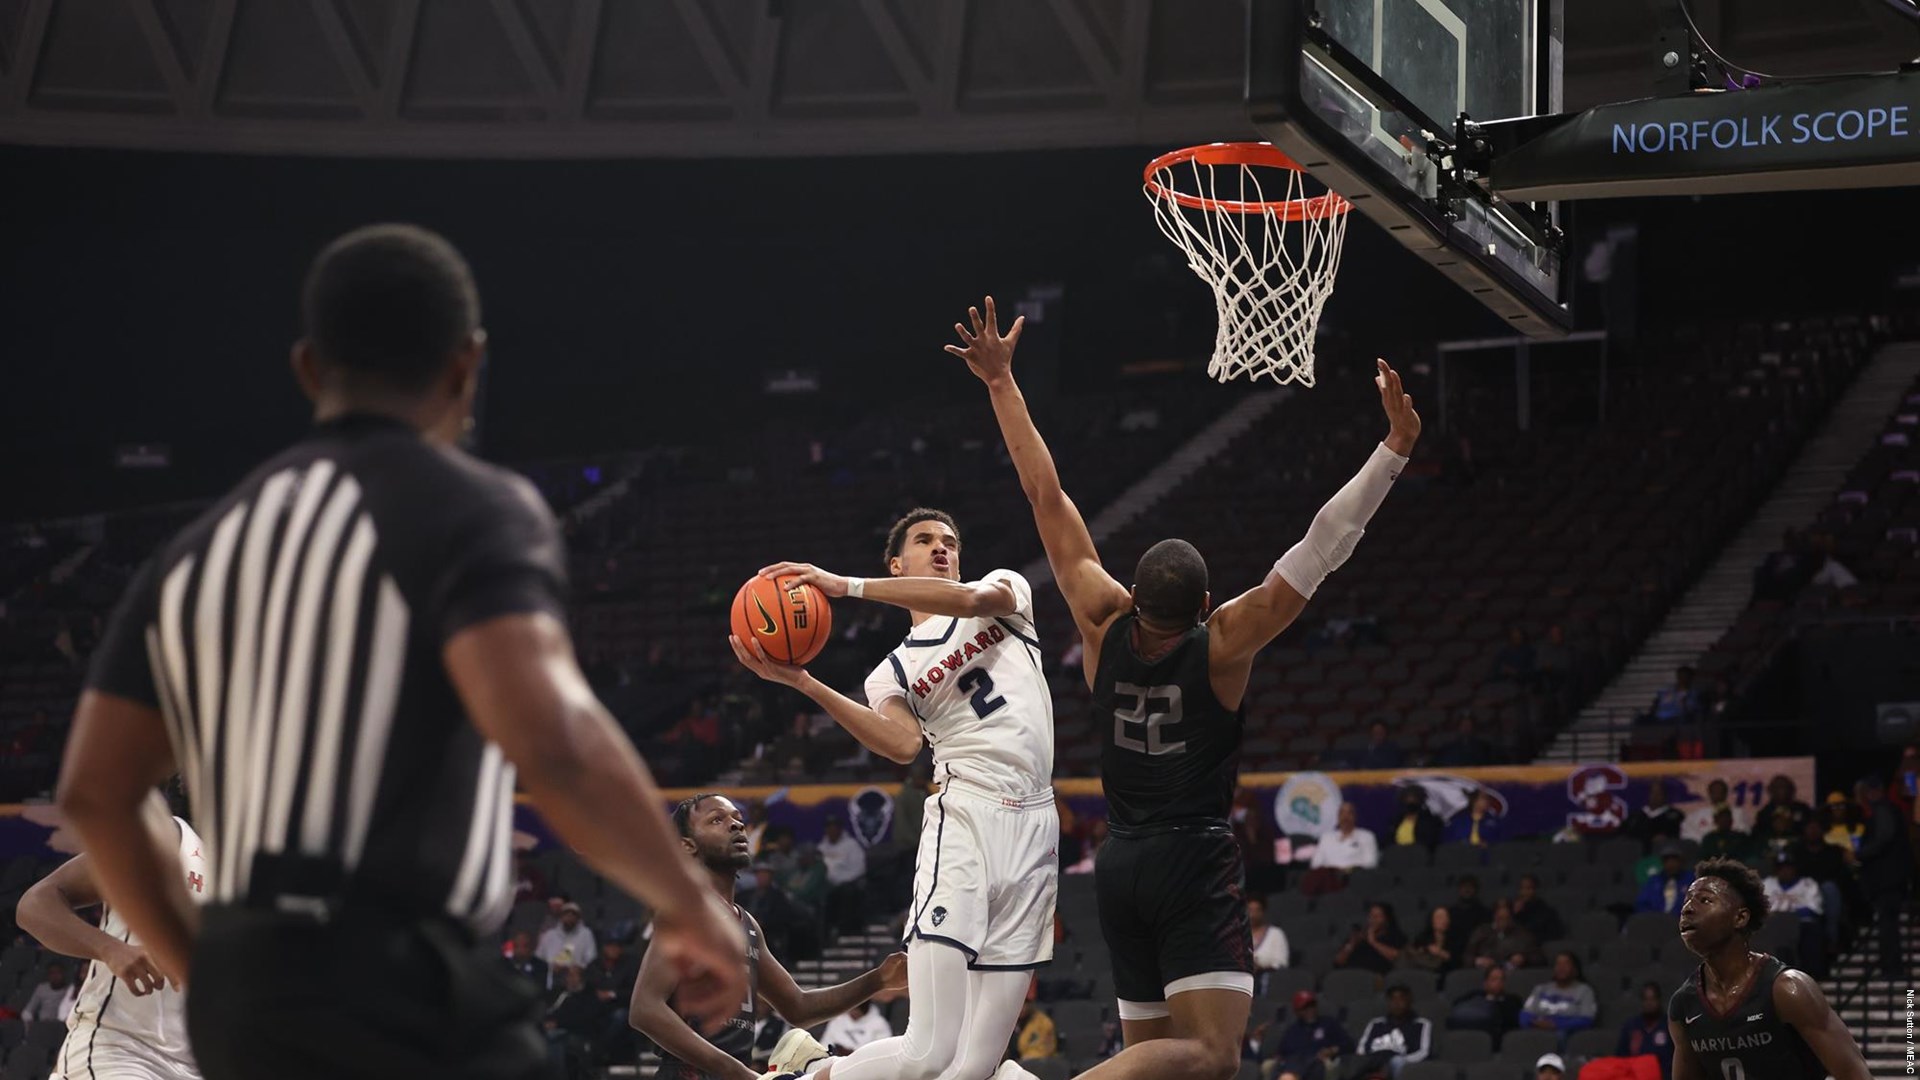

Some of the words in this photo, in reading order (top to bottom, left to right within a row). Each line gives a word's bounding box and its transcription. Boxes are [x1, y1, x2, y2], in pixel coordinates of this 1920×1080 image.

[1612, 114, 1782, 153] NORFOLK
[1791, 106, 1909, 144] SCOPE
[785, 580, 808, 630] LITE
[911, 623, 1005, 699] HOWARD
[957, 667, 1007, 720] 2
[1113, 681, 1187, 756] 22
[1690, 1031, 1773, 1052] MARYLAND
